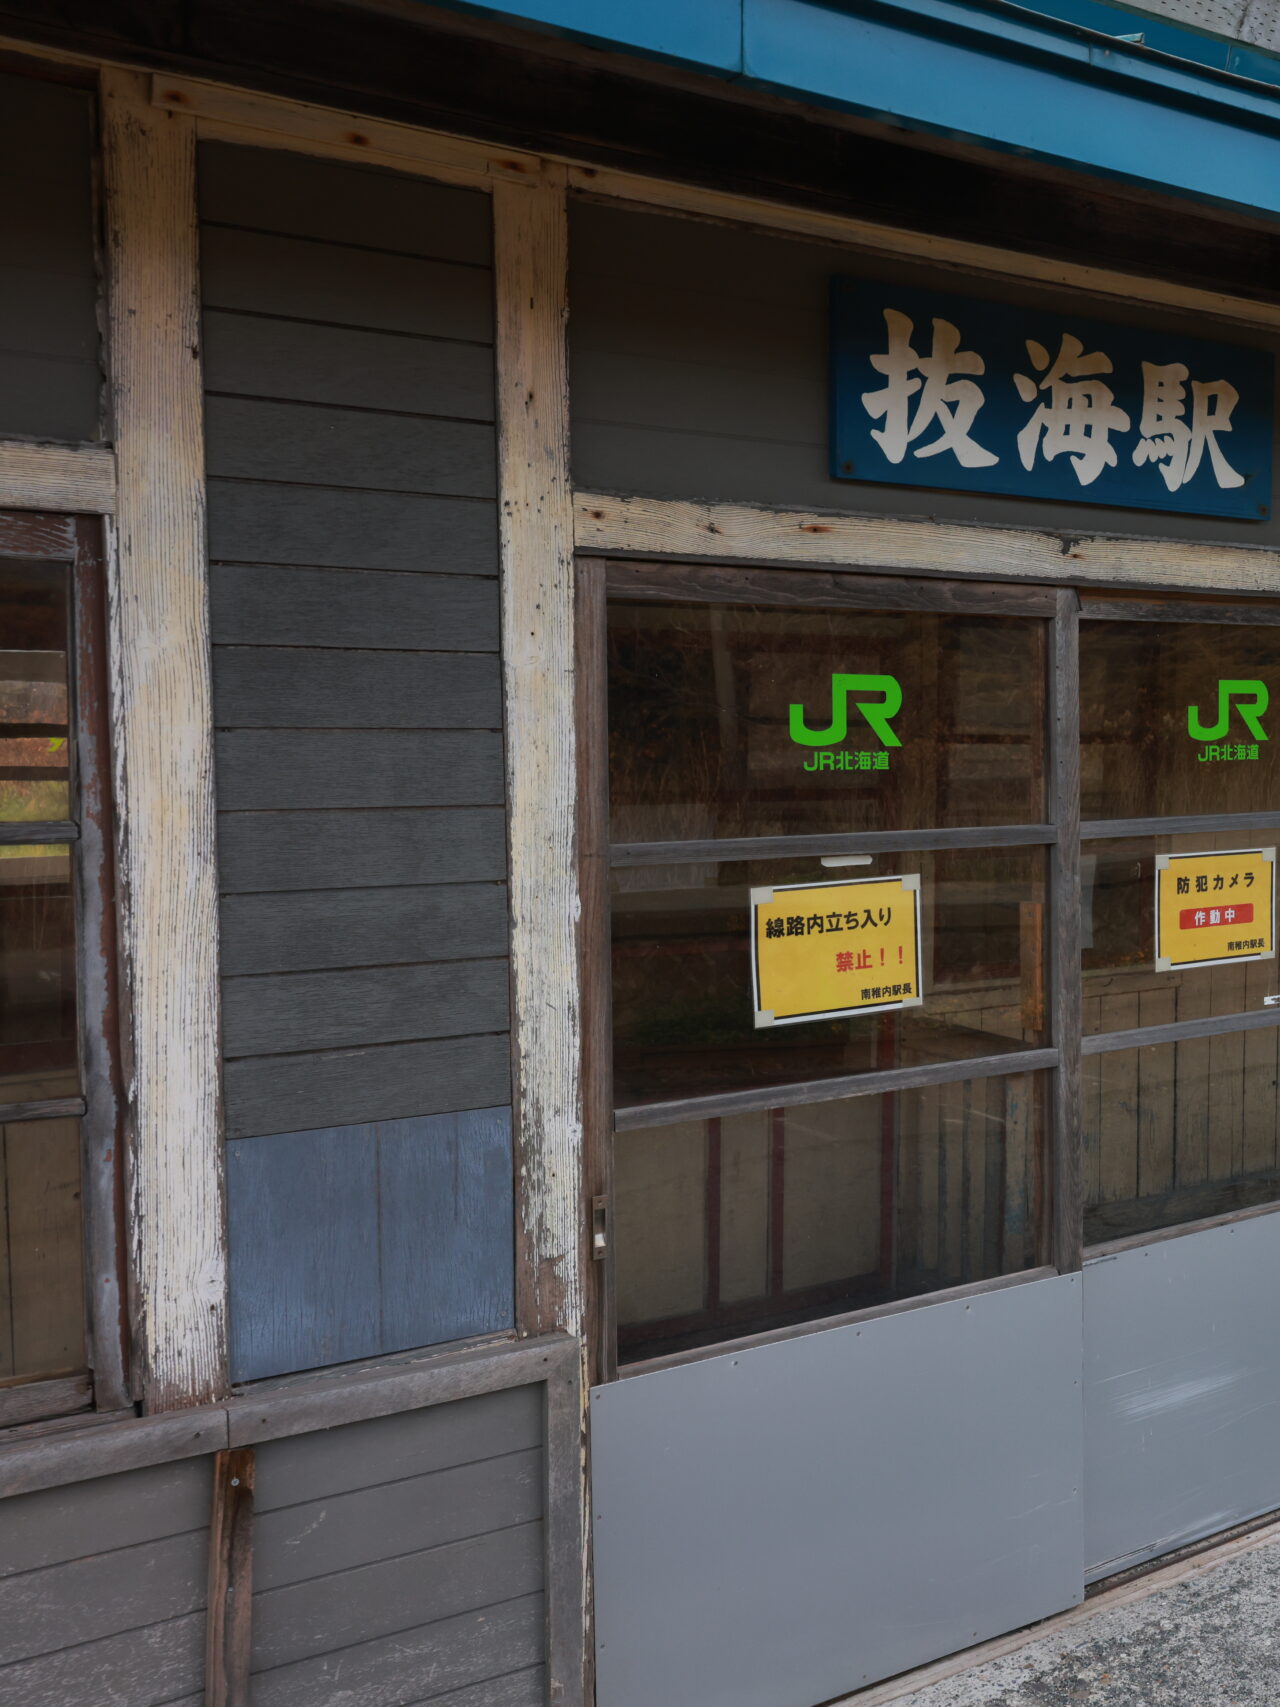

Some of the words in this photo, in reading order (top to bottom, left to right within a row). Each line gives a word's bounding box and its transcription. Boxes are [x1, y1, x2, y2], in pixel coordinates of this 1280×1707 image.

[861, 307, 1246, 493] 抜海駅
[789, 673, 903, 747] JR
[1188, 679, 1269, 741] JR
[803, 750, 890, 771] JR北海道
[1197, 744, 1260, 762] JR北海道
[1176, 872, 1255, 895] 防犯カメラ
[765, 907, 893, 939] 線路内立ち入り
[1194, 908, 1236, 927] 作動中
[1227, 938, 1265, 952] 南稚内駅長
[860, 982, 913, 1001] 南稚内駅長
